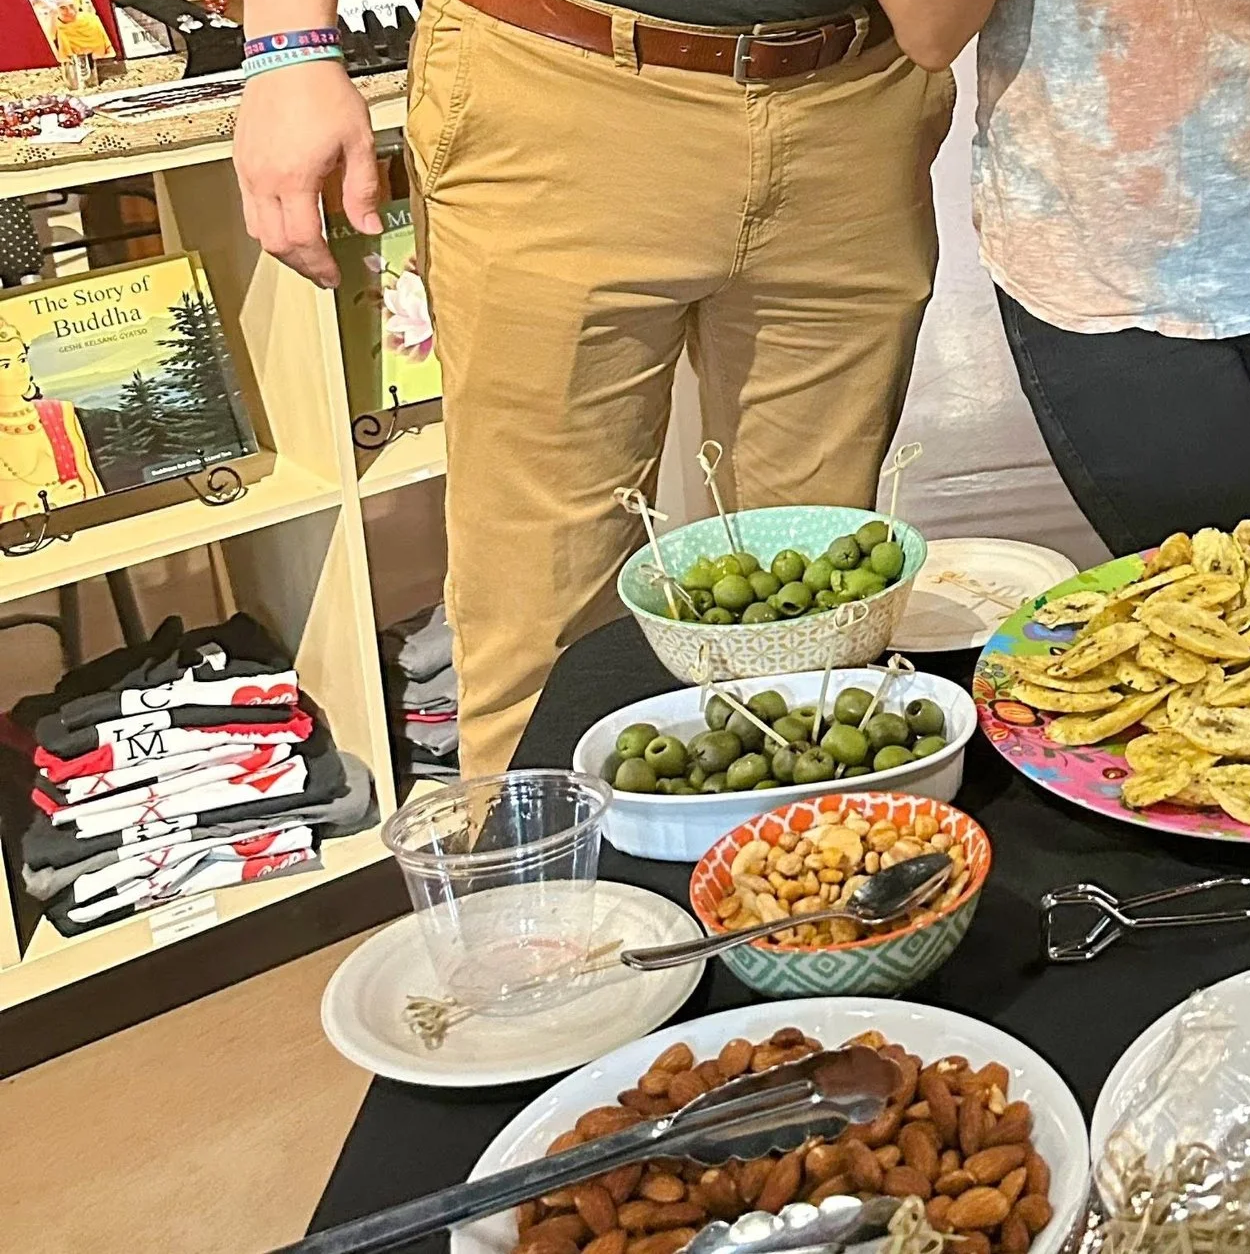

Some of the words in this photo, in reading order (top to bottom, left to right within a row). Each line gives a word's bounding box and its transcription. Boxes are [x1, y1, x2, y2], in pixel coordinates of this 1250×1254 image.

[28, 297, 69, 316] The
[72, 283, 124, 307] Story
[130, 274, 151, 294] of
[52, 305, 143, 339] Buddha
[84, 334, 118, 348] KELSANG
[119, 327, 148, 341] GYATSO
